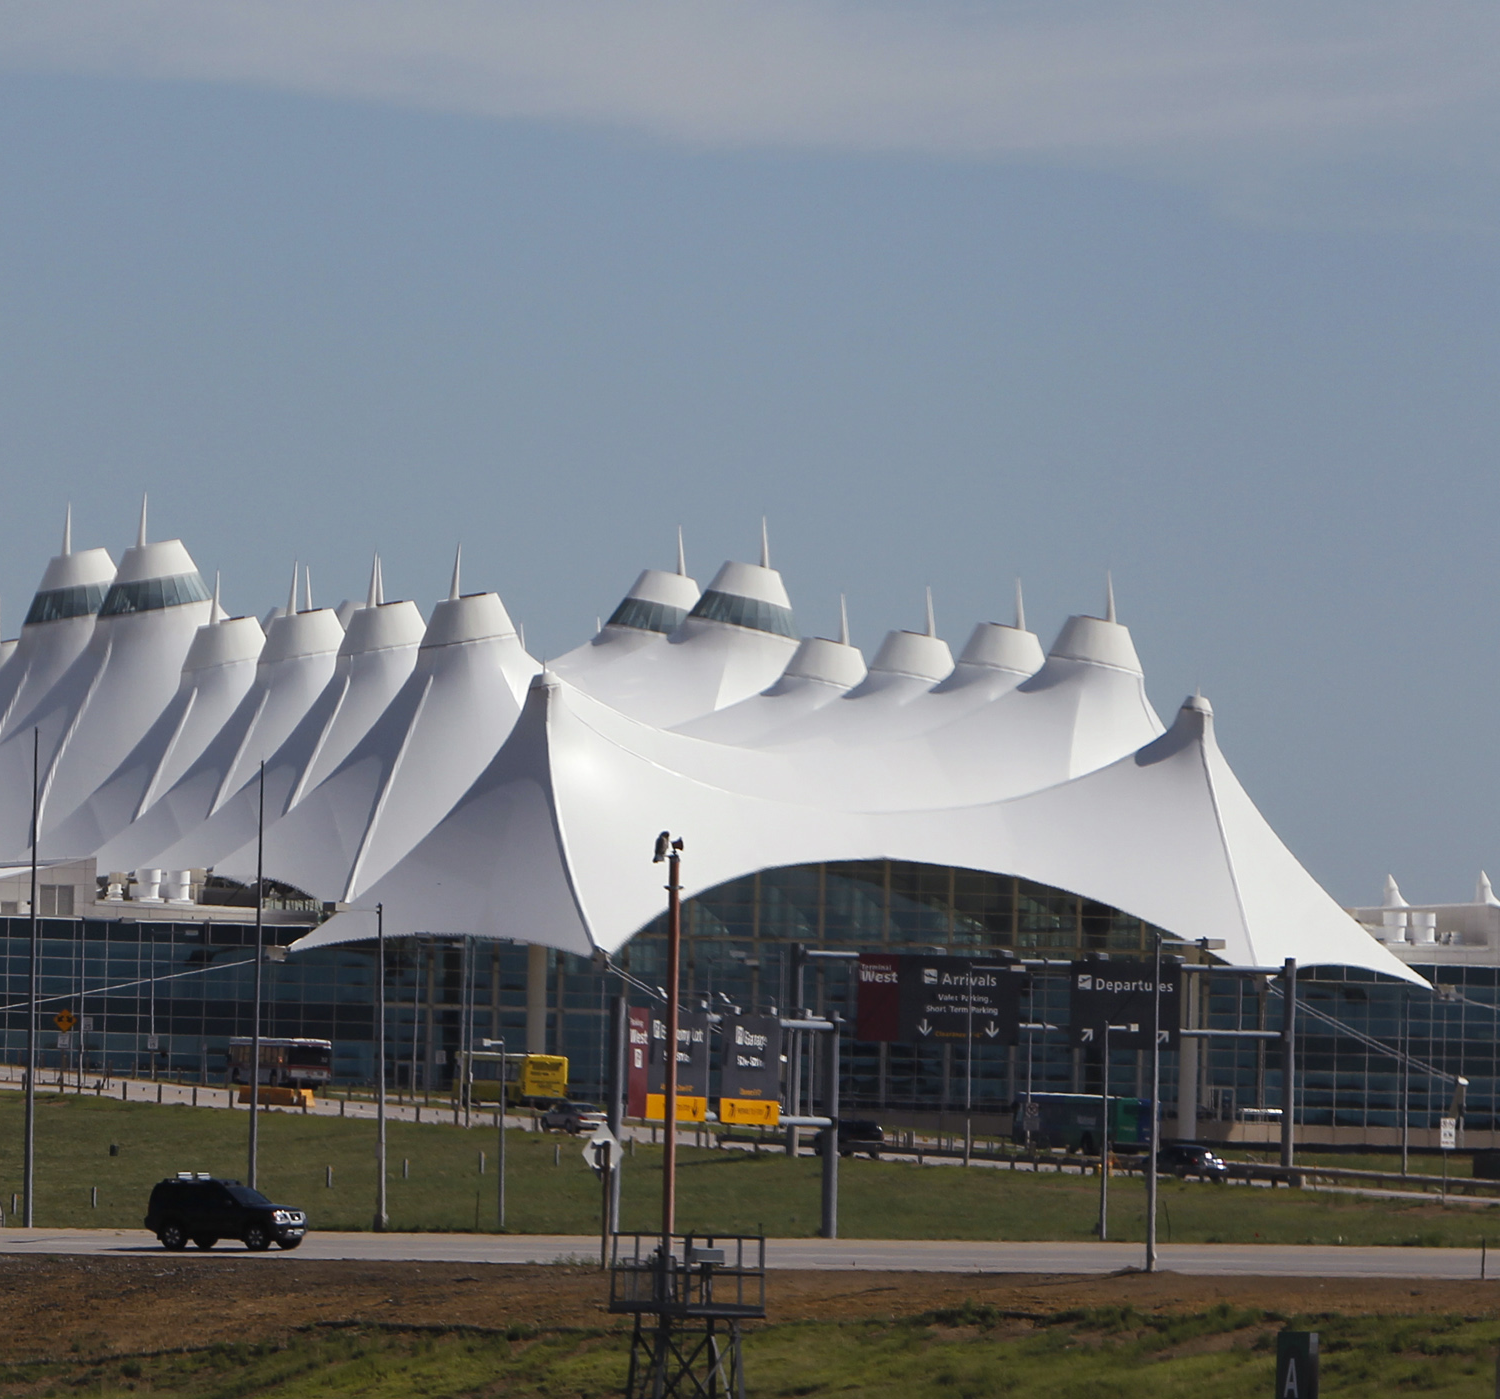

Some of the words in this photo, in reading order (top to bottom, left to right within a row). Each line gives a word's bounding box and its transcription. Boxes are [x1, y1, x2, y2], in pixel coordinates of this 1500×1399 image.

[861, 963, 892, 971] Terminal
[860, 970, 898, 983] West
[942, 972, 997, 987] Arrivals
[1095, 978, 1174, 994] Departues
[938, 993, 958, 1001] Valet
[926, 1005, 946, 1013] Short
[949, 1005, 969, 1013] Term
[971, 1006, 998, 1016] Parking
[630, 1028, 648, 1045] West
[1283, 1358, 1299, 1398] A
